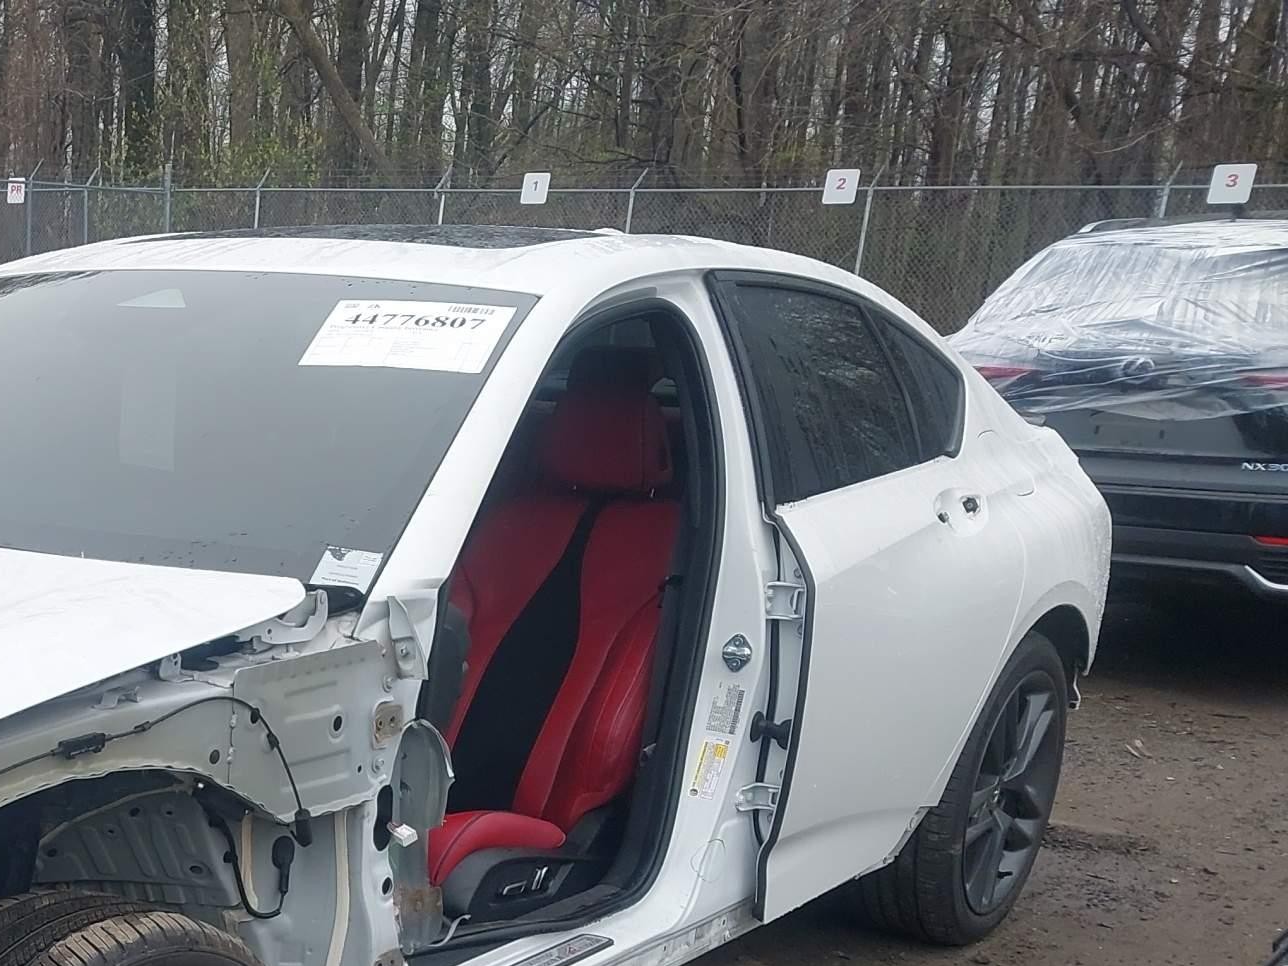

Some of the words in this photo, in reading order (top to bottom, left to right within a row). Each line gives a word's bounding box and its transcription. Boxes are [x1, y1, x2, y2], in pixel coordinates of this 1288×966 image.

[532, 180, 539, 192] 1
[835, 177, 847, 190] 2
[1224, 173, 1240, 188] 3
[10, 185, 22, 194] PR
[344, 312, 487, 330] 44776807
